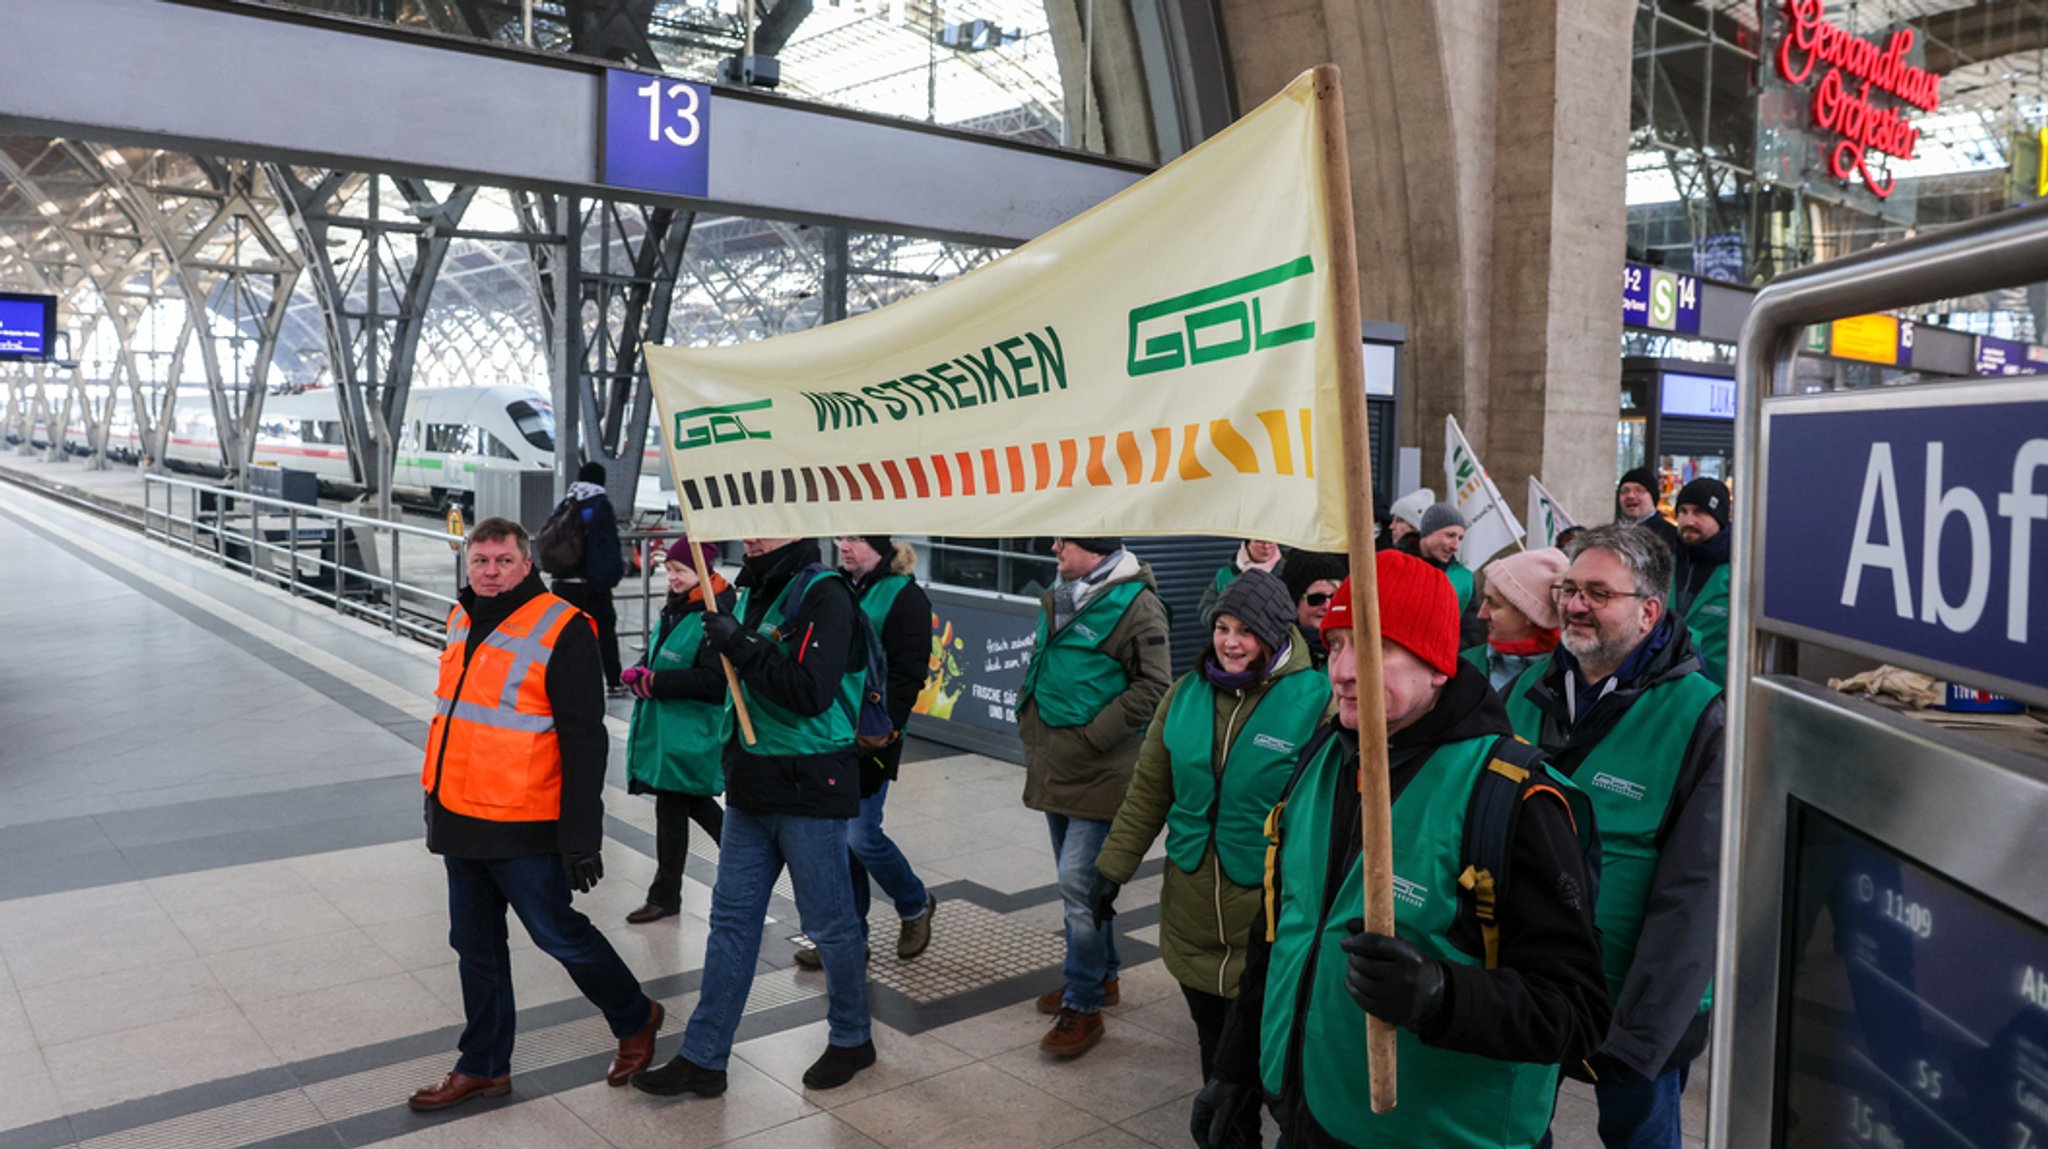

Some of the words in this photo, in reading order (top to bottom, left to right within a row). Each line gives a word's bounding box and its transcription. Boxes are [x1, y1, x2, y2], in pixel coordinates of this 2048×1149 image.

[1782, 0, 1940, 112] Gewandhaus
[638, 80, 700, 147] 13
[1815, 67, 1920, 197] Orchester
[1624, 268, 1642, 291] 1-2
[1654, 279, 1672, 321] S
[1678, 276, 1696, 310] 14
[1127, 255, 1315, 377] GDL
[1901, 322, 1914, 348] 15
[800, 391, 878, 431] WIR
[861, 325, 1068, 421] STREIKEN
[675, 398, 772, 450] GDL
[1840, 438, 2048, 643] Abf
[972, 684, 1001, 703] FRISCHE
[989, 704, 1003, 719] UND
[1884, 888, 1933, 939] 11:09
[1851, 1096, 1873, 1140] 15
